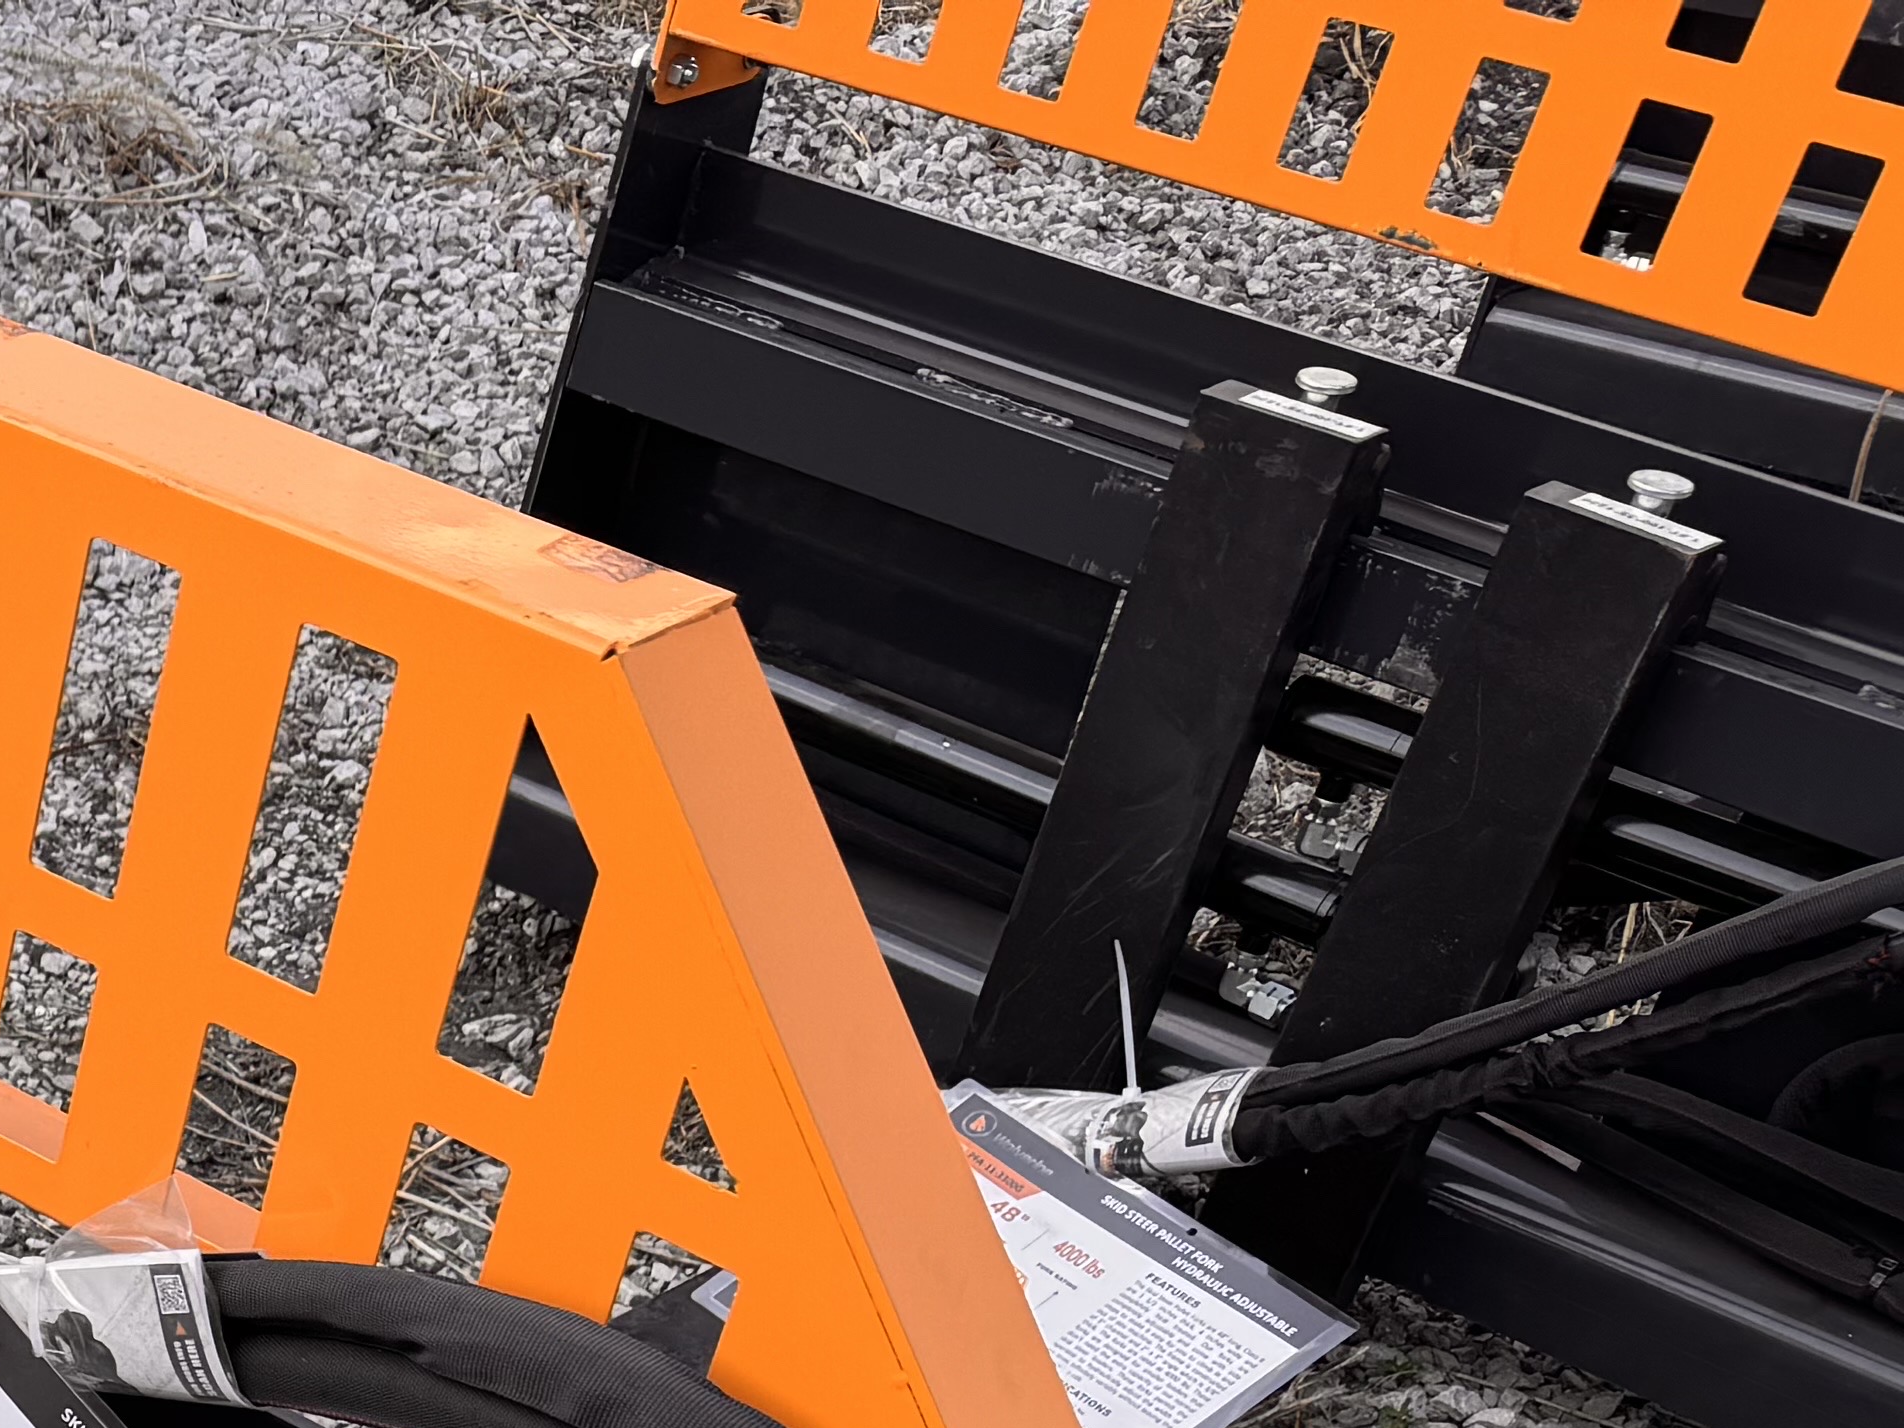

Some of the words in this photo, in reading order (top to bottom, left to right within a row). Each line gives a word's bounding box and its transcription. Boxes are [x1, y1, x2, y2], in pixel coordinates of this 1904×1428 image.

[991, 1200, 1031, 1222] 48"
[1100, 1194, 1128, 1214] SKID
[1123, 1209, 1159, 1234] STEER
[1154, 1228, 1196, 1255] PALLET
[1189, 1250, 1224, 1273] FORK
[1052, 1240, 1090, 1267] 4000
[1081, 1257, 1105, 1279] lbs
[1144, 1272, 1201, 1308] FEATURES
[1170, 1255, 1234, 1297] HYDRAULIC
[1228, 1292, 1298, 1337] ADJUSTABLE
[185, 1339, 203, 1368] HERE
[195, 1369, 218, 1397] SCAN
